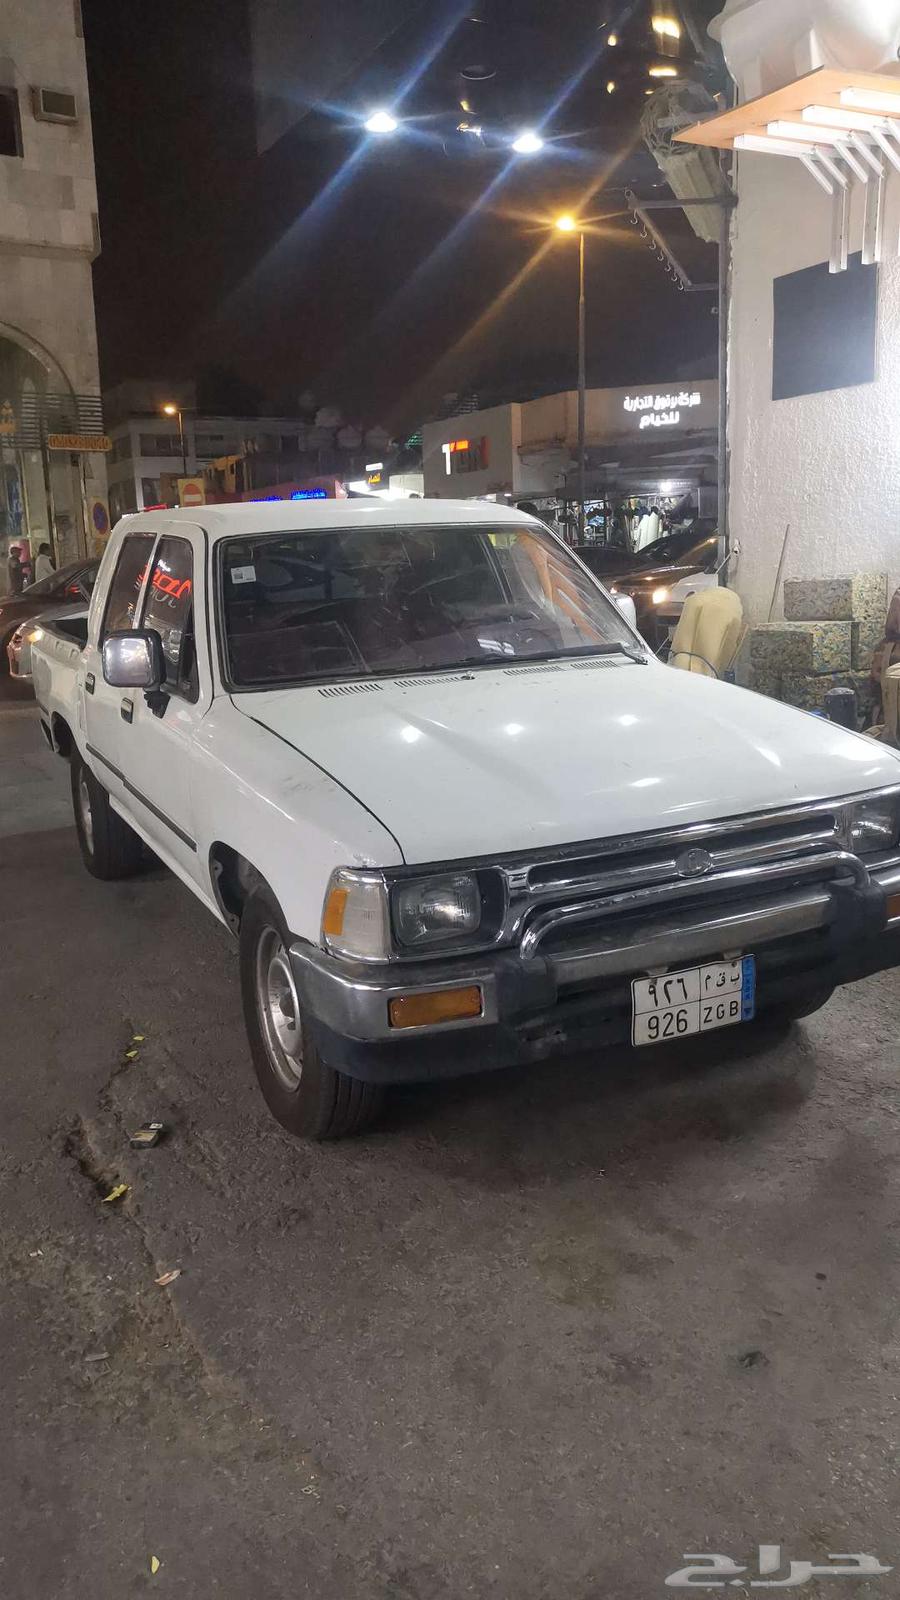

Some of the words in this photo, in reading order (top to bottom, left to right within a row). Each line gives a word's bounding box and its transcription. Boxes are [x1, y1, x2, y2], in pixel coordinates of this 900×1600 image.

[623, 394, 653, 412] التجارية
[678, 391, 701, 407] شركة
[639, 411, 680, 430] للخيام
[648, 978, 688, 1007] ٩٢٦
[648, 1009, 688, 1040] 926
[703, 1000, 739, 1024] ZGB
